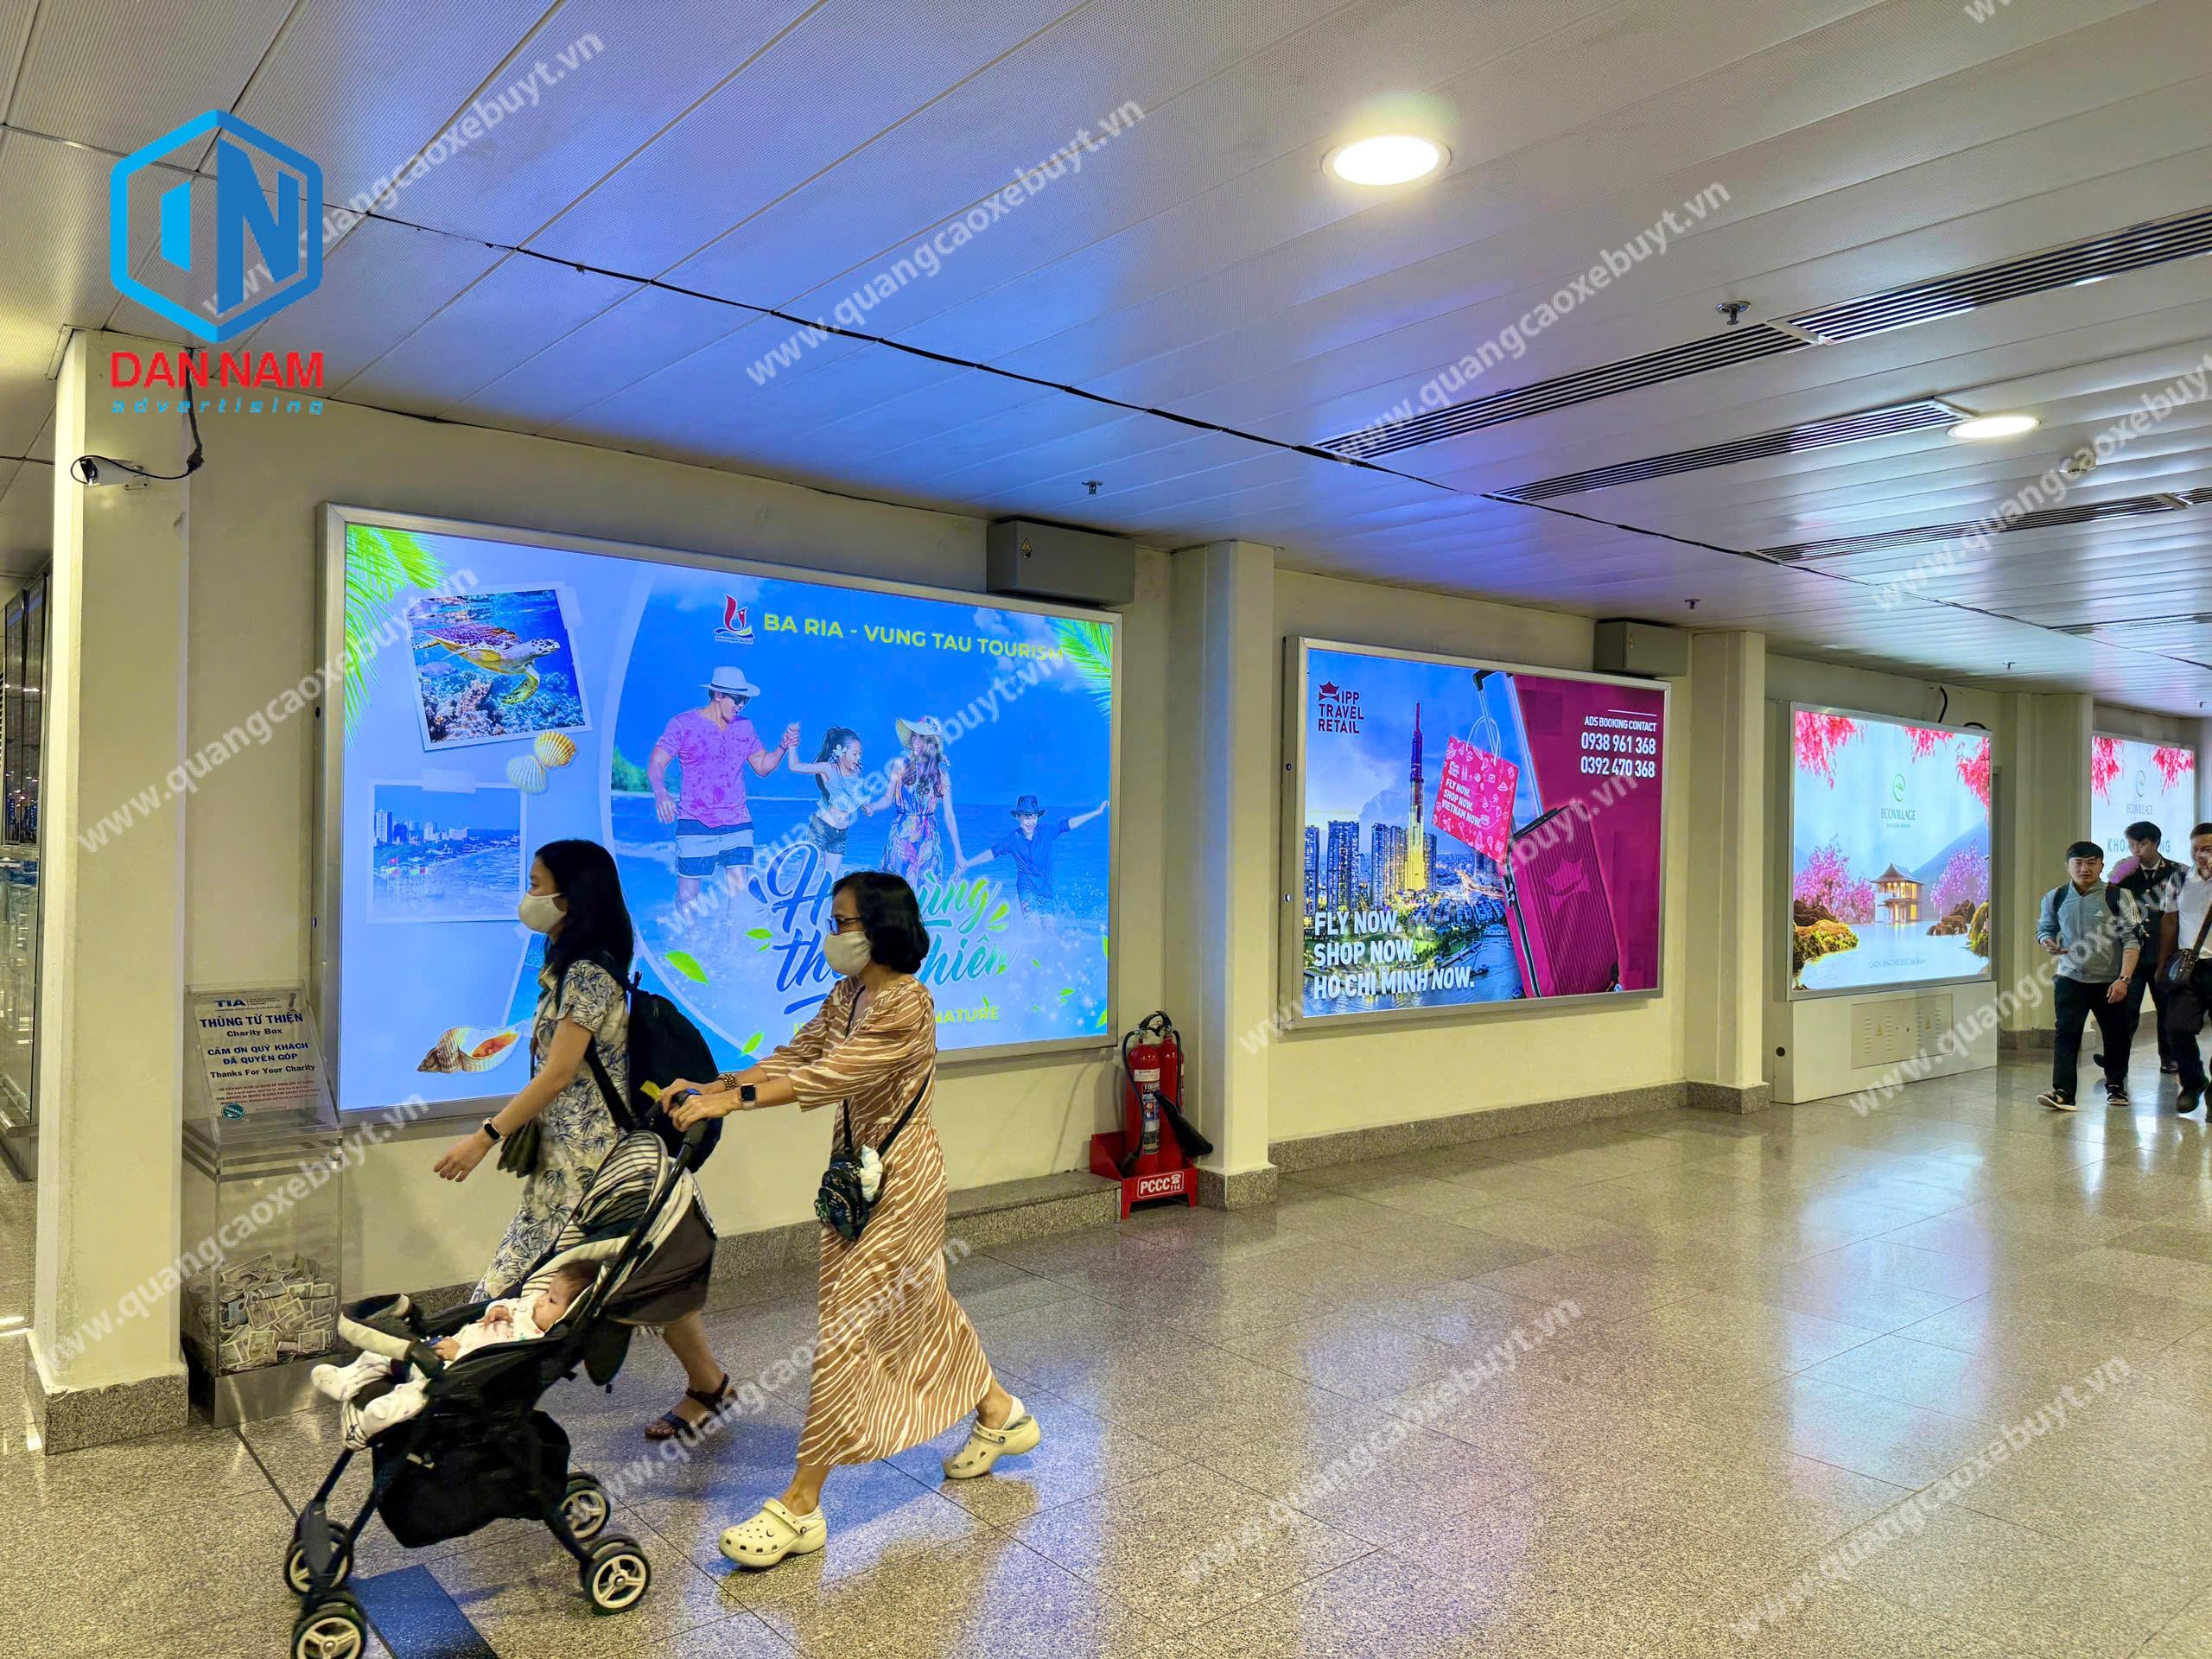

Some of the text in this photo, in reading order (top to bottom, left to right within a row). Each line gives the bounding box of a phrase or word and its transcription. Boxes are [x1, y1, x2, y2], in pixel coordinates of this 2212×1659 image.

[764, 613, 798, 633] BA
[805, 619, 843, 639] RIA
[864, 625, 926, 648] VUNG
[931, 632, 971, 653] TAU
[977, 638, 1064, 663] TOURISM
[1341, 690, 1360, 705] IPP
[1319, 703, 1364, 720] TRAVEL
[1318, 719, 1360, 734] RETAIL
[1584, 715, 1657, 732] ADS BOOKING CONTACT
[1581, 732, 1656, 755] 0938 961 368
[1580, 755, 1656, 779] 0392 470 368
[1446, 778, 1471, 798] FLY NOW.
[1443, 788, 1473, 812] SHOP NOW.
[1441, 798, 1481, 829] VIETNAM NOW.
[918, 871, 990, 934] ùng
[1314, 910, 1402, 936] FLY NOW.
[920, 934, 1007, 987] hiên
[1313, 938, 1417, 967] SHOP NOW.
[1314, 966, 1475, 1000] HO CHI MINH NOW.
[214, 999, 246, 1007] TIA
[200, 1012, 303, 1027] THÙNG TỪ THIỆN
[210, 1070, 243, 1078] Thanks
[263, 1066, 283, 1075] Your
[1140, 1177, 1171, 1194] PCCC
[1171, 1183, 1180, 1192] 114
